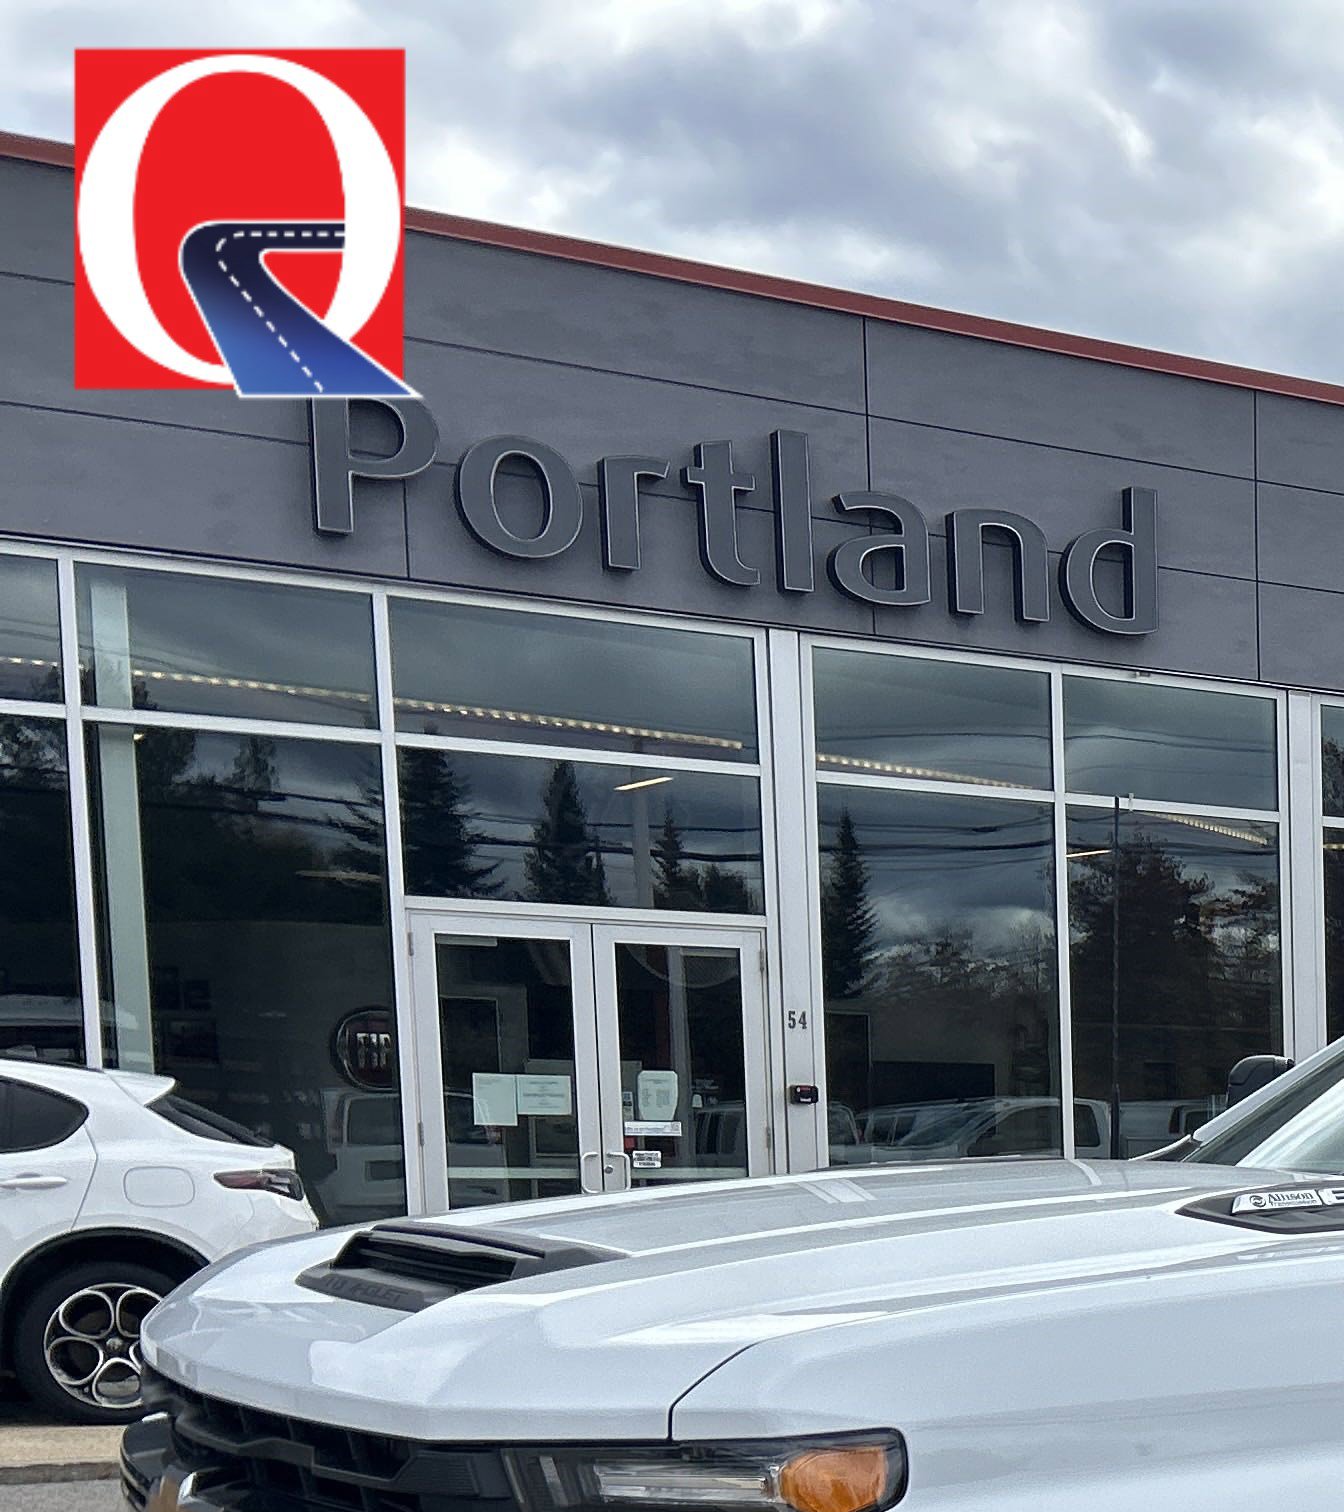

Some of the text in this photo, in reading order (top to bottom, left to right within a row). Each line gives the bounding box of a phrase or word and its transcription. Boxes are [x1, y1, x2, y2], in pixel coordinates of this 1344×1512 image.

[308, 397, 1159, 636] Portland
[788, 1010, 808, 1030] 54
[1268, 1192, 1314, 1204] Allison
